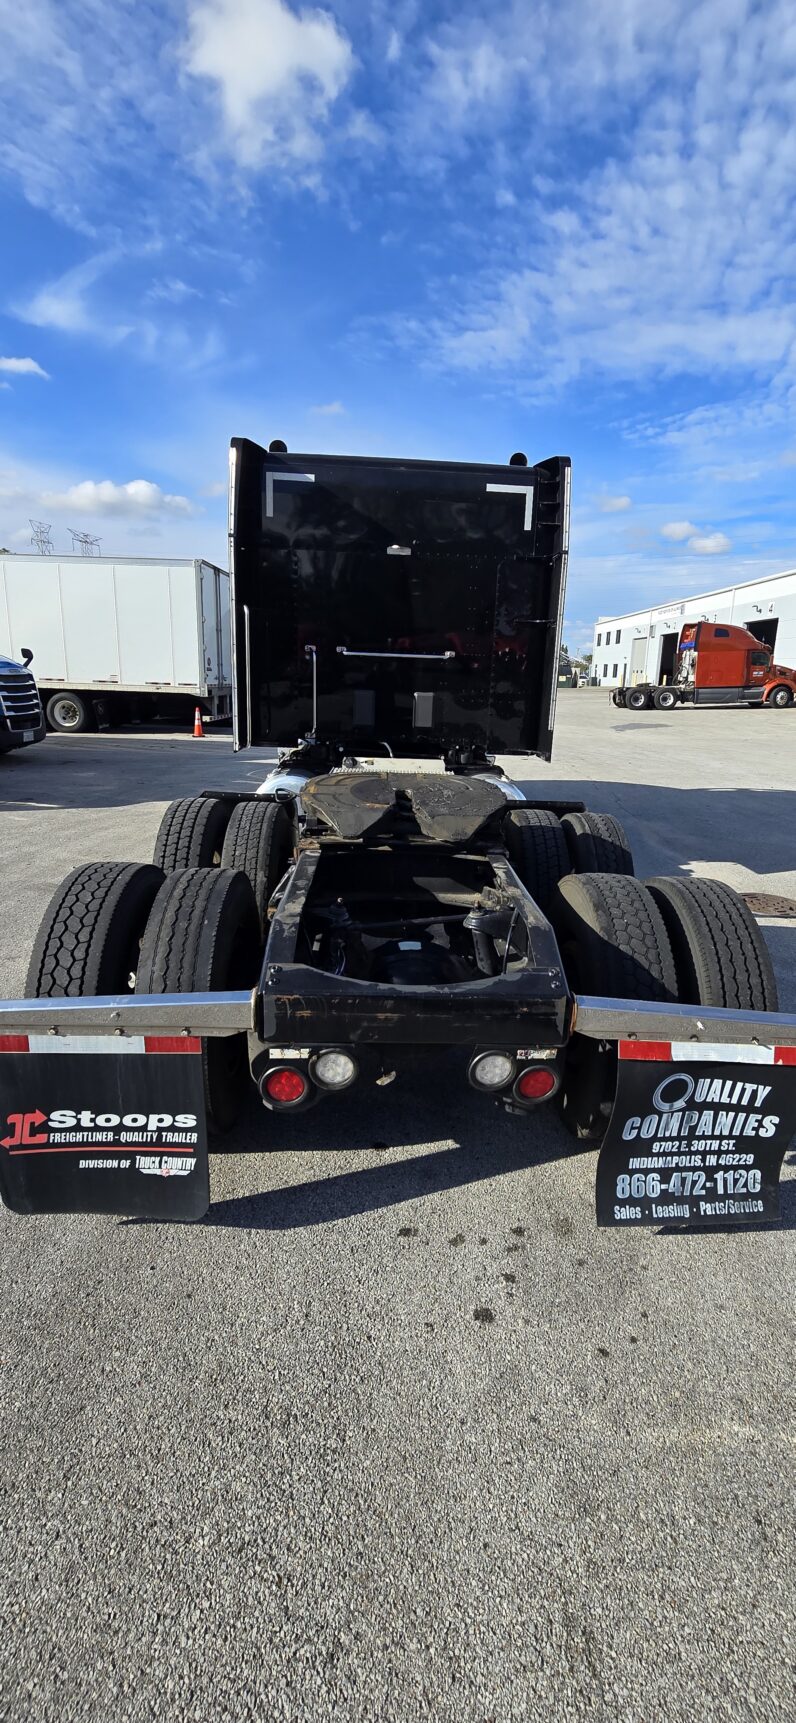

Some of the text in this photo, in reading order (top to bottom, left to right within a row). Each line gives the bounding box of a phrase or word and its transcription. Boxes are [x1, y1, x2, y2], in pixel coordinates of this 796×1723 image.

[652, 1073, 772, 1112] QUALITY
[48, 1110, 197, 1130] Stoops
[621, 1111, 780, 1140] COMPANIES
[161, 1132, 198, 1143] TRAILER
[652, 1140, 736, 1153] 9702 E. 30TH ST.
[79, 1156, 196, 1171] DIVISION OF TRUCK COUNTRY
[629, 1154, 754, 1169] INDIANAPOLIS, IN 46229
[616, 1169, 762, 1199] 866-472-1120
[614, 1199, 764, 1220] Sales Leasing Parts/Service
